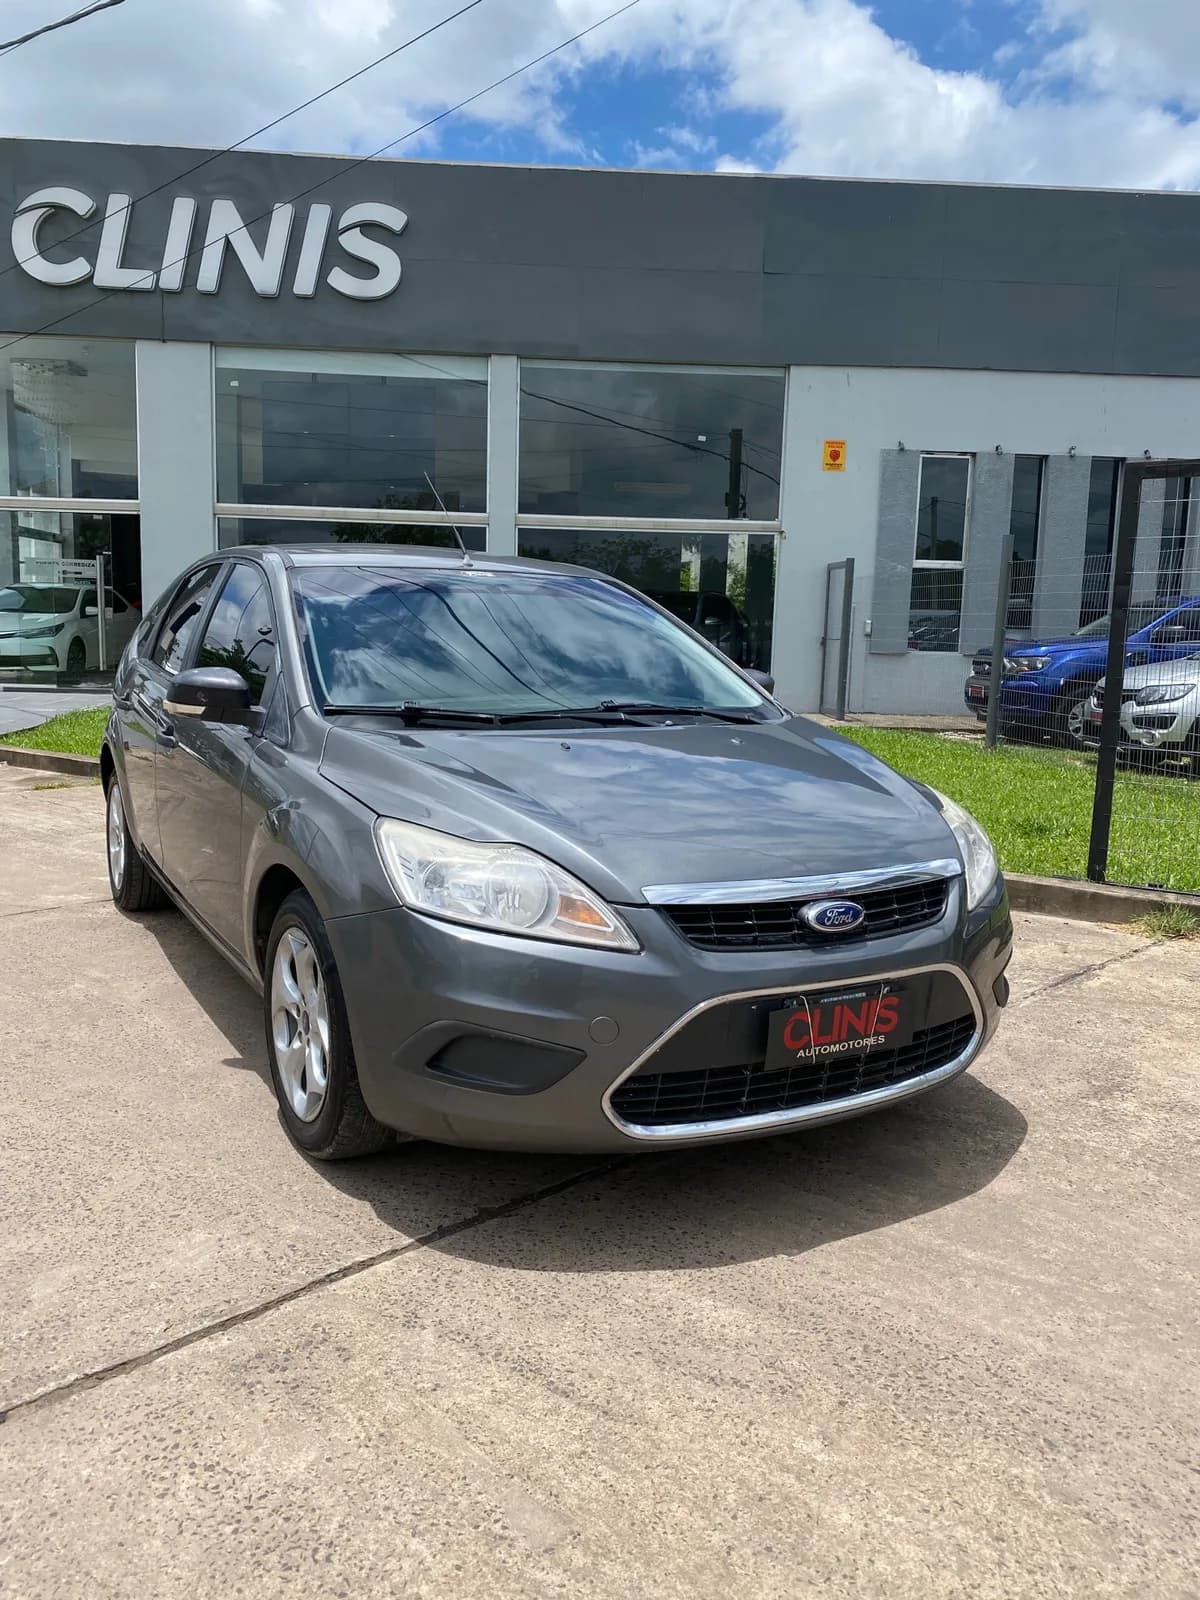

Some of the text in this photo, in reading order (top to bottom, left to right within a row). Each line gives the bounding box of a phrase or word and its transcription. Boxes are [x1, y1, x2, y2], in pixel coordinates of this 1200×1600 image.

[11, 186, 409, 300] CLINIS
[825, 908, 853, 925] Ford
[783, 995, 900, 1049] CLINIS
[796, 1035, 886, 1058] AUTOMOTORES
